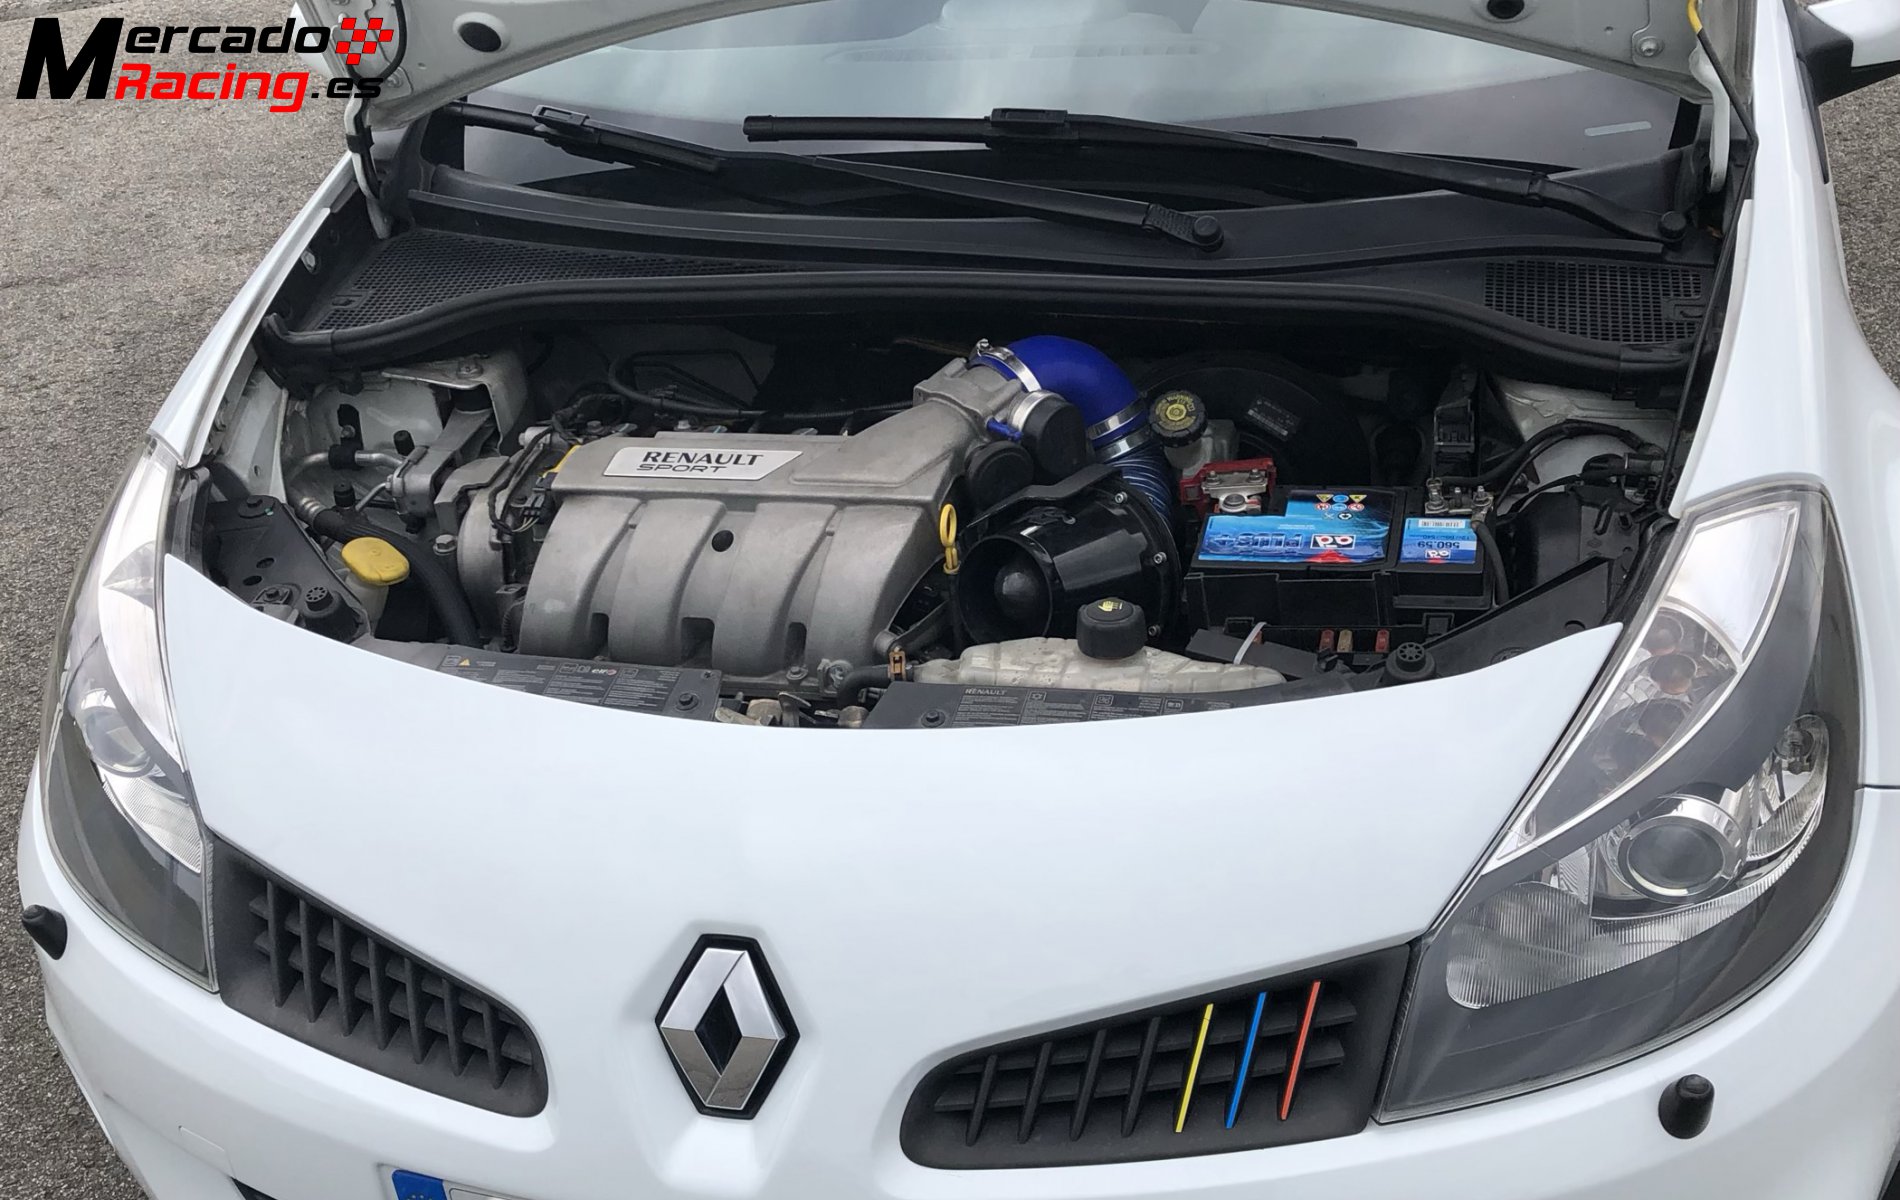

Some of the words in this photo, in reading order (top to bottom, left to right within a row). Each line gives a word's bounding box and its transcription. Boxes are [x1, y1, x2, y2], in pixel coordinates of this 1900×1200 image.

[642, 451, 764, 466] RENAULT
[636, 463, 728, 473] SPORT
[1417, 541, 1460, 549] 560.59
[965, 688, 1008, 696] RENAULT
